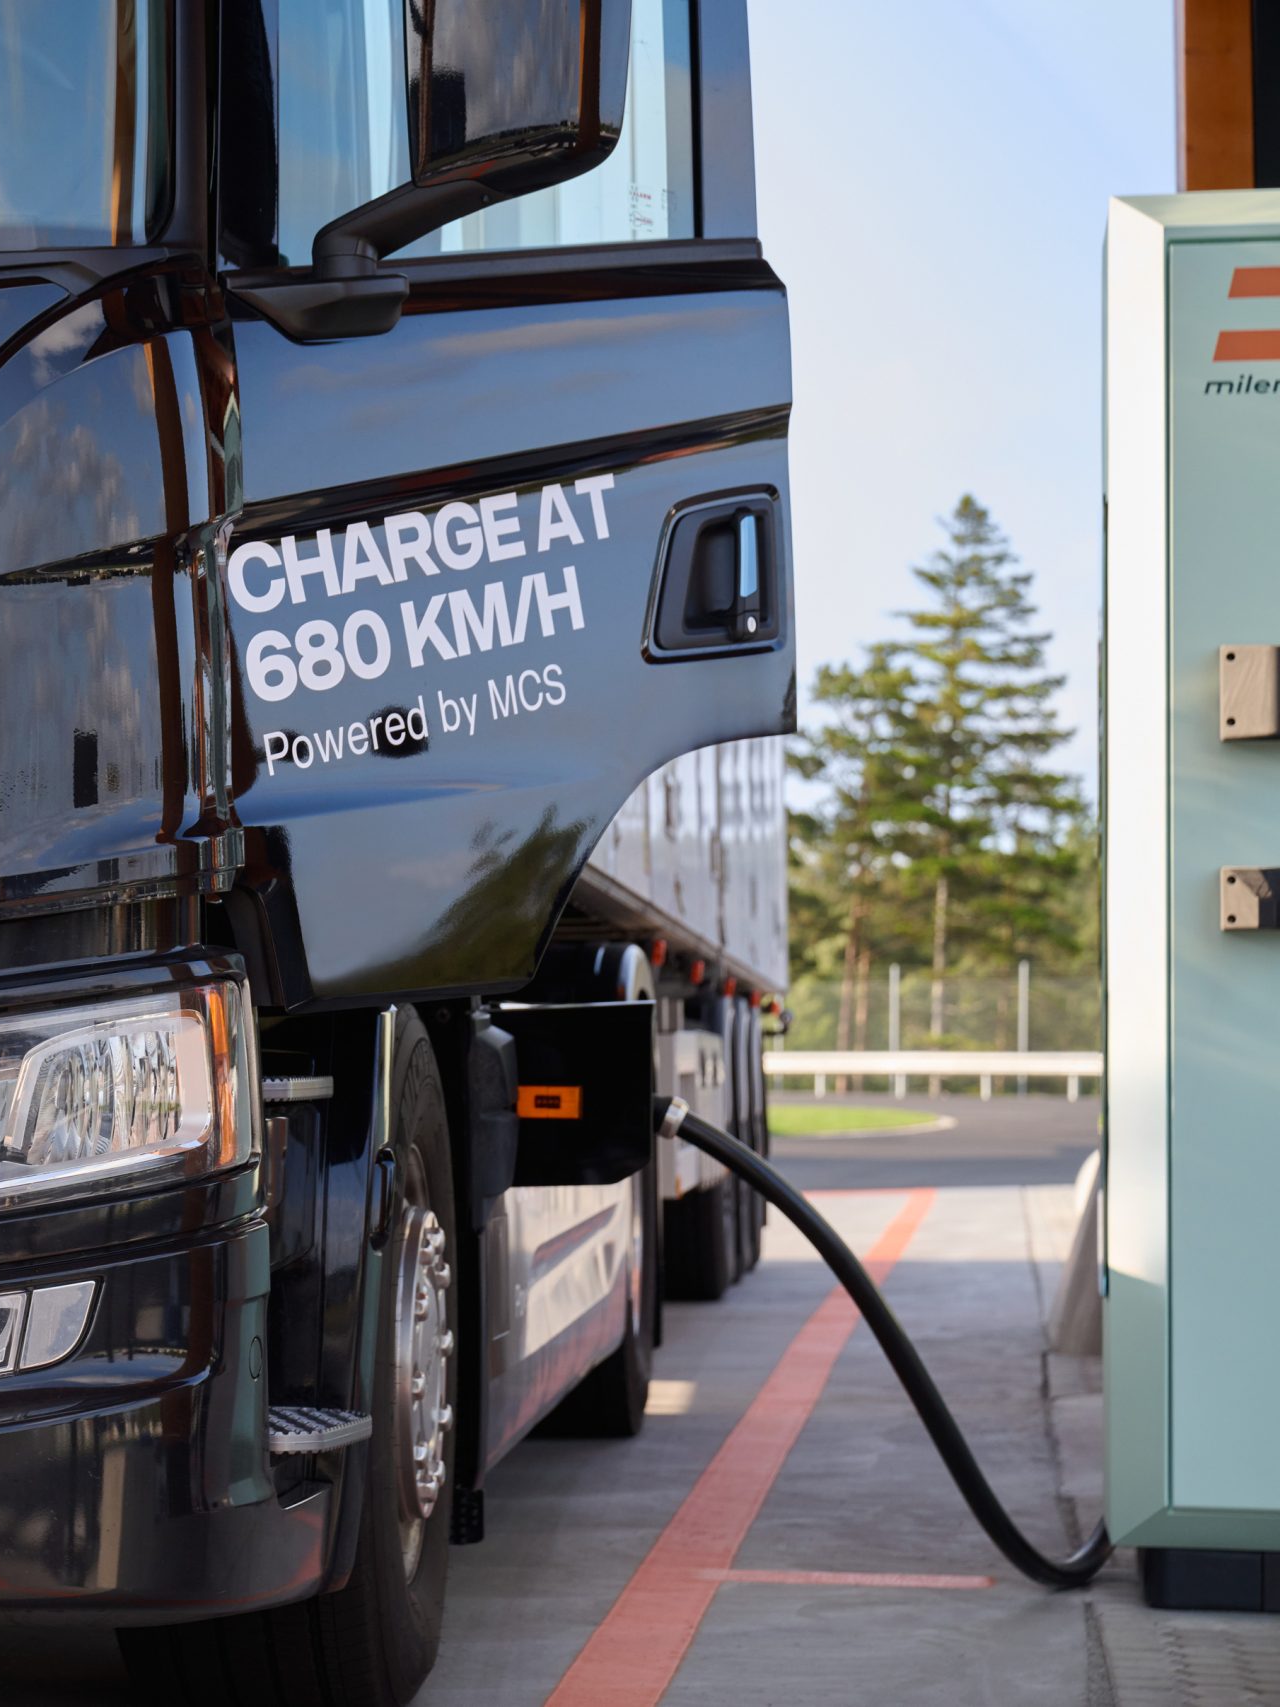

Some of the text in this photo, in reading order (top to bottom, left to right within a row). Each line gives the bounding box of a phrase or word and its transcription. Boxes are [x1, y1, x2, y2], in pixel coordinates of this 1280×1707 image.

[227, 473, 615, 613] CHARGE AT
[245, 565, 585, 702] 680 KM/H
[263, 663, 567, 776] Powered by MCS
